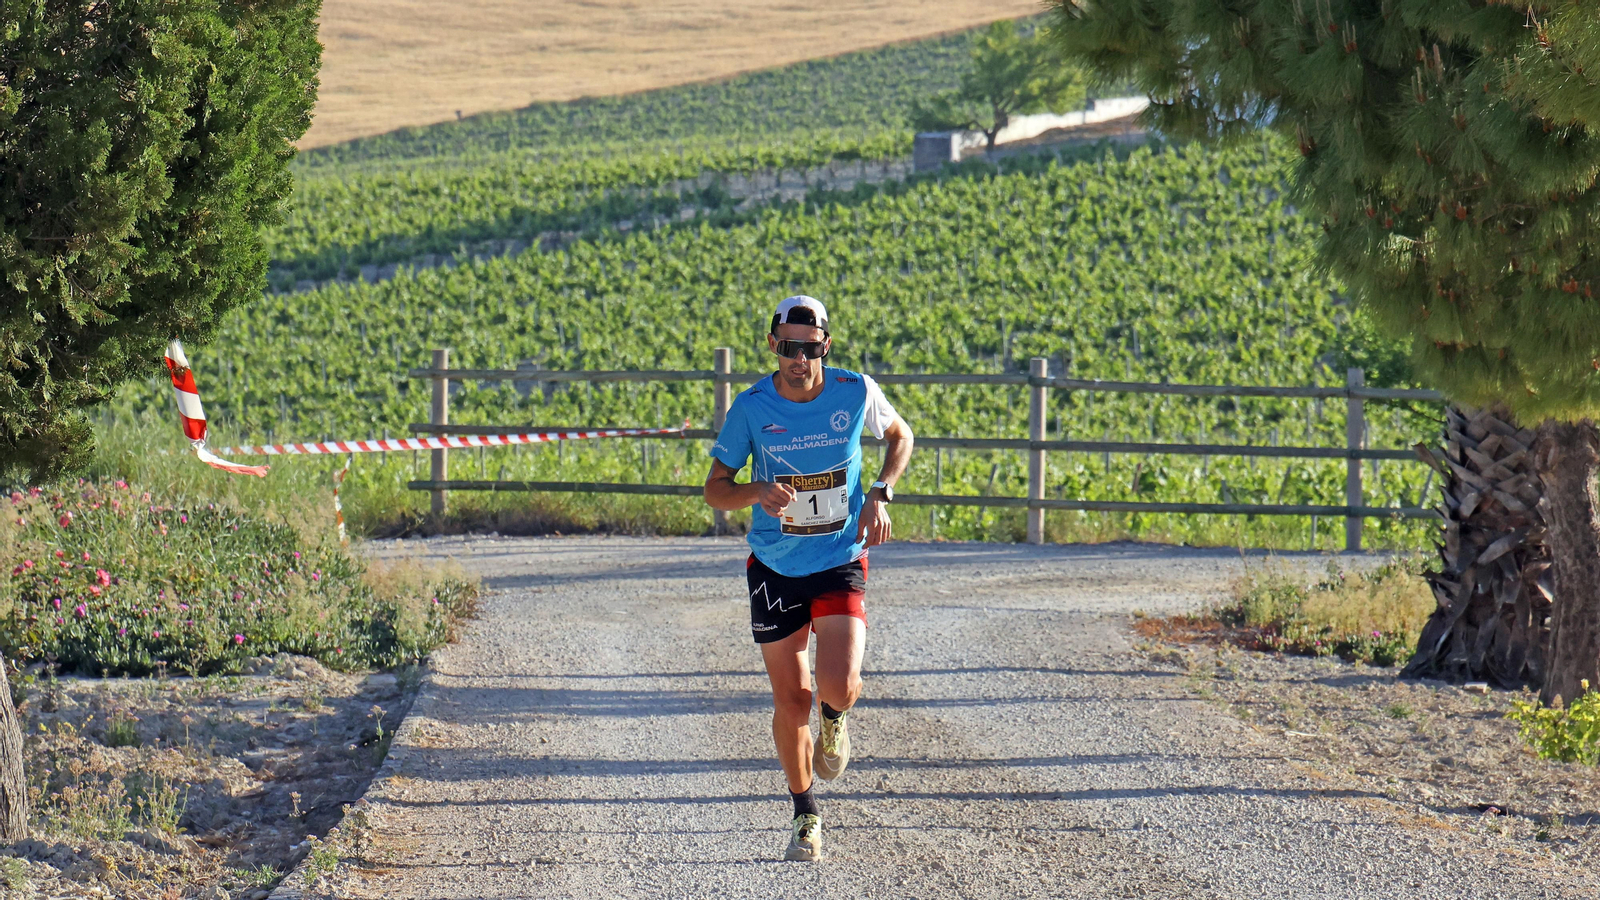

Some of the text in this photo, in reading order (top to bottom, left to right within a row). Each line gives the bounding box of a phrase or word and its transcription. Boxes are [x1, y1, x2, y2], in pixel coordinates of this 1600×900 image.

[769, 437, 849, 452] BENALMADENA
[791, 433, 828, 443] ALPINO
[795, 476, 829, 488] Sherry
[808, 494, 818, 515] 1
